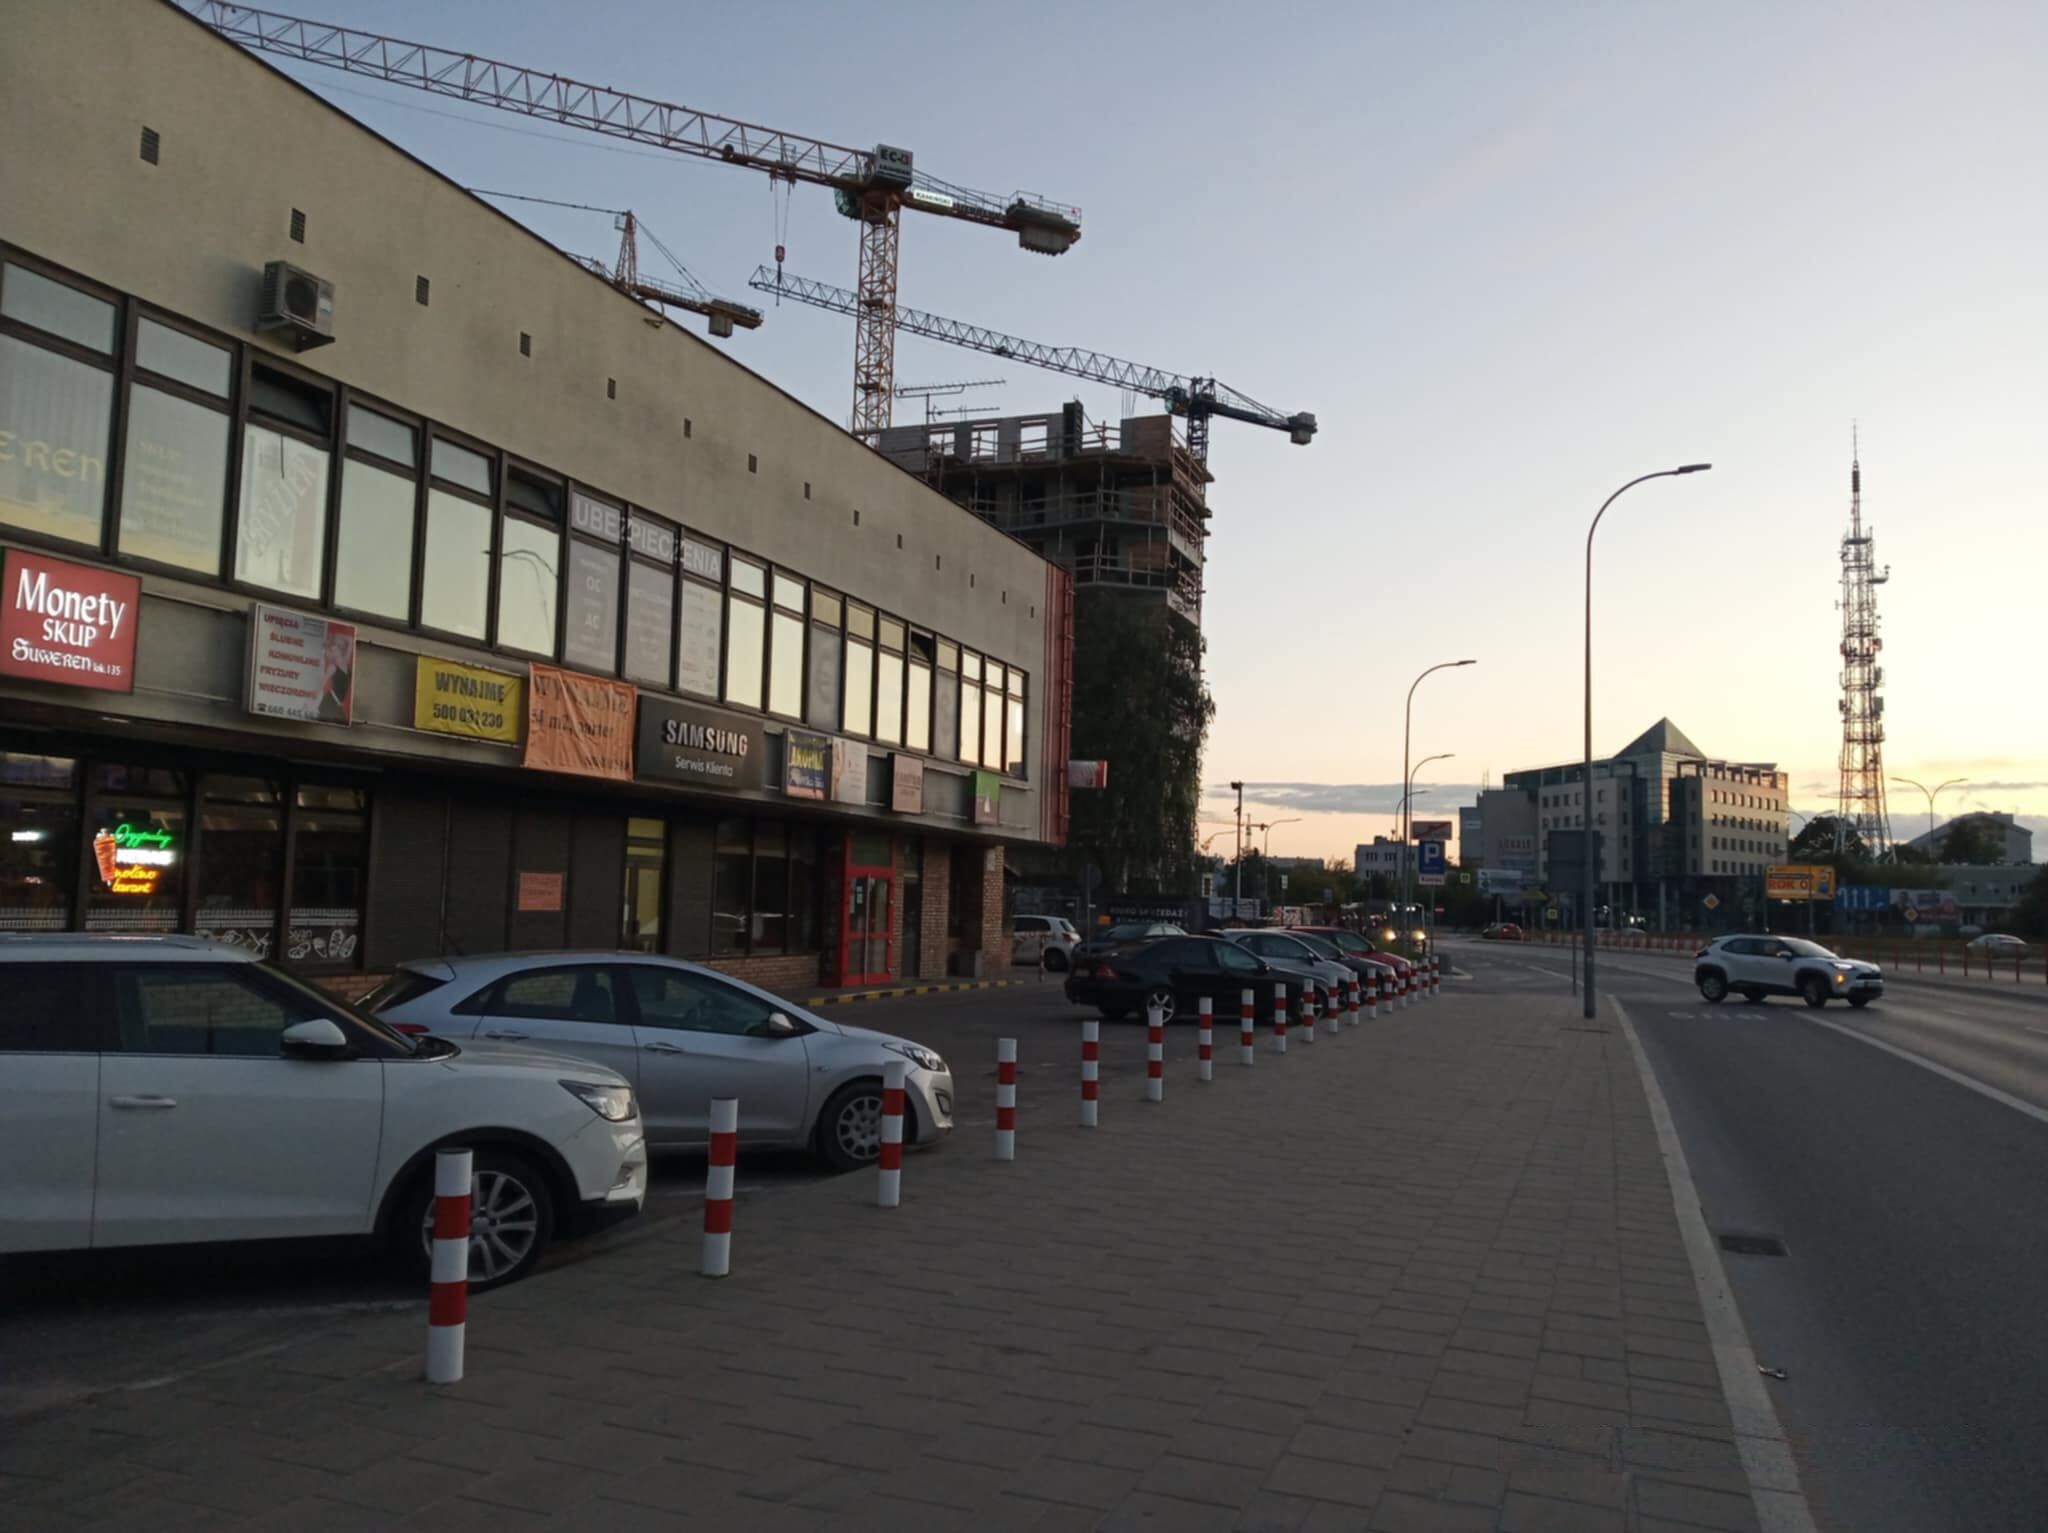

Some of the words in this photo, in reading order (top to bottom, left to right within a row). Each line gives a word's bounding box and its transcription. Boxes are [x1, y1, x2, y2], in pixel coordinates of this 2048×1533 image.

[16, 567, 125, 639] Monety
[42, 618, 97, 648] SKUP
[433, 703, 457, 721] 500
[481, 711, 504, 730] 230
[665, 718, 749, 757] SAMSUNG
[674, 755, 705, 773] Serwis
[1424, 843, 1440, 864] P
